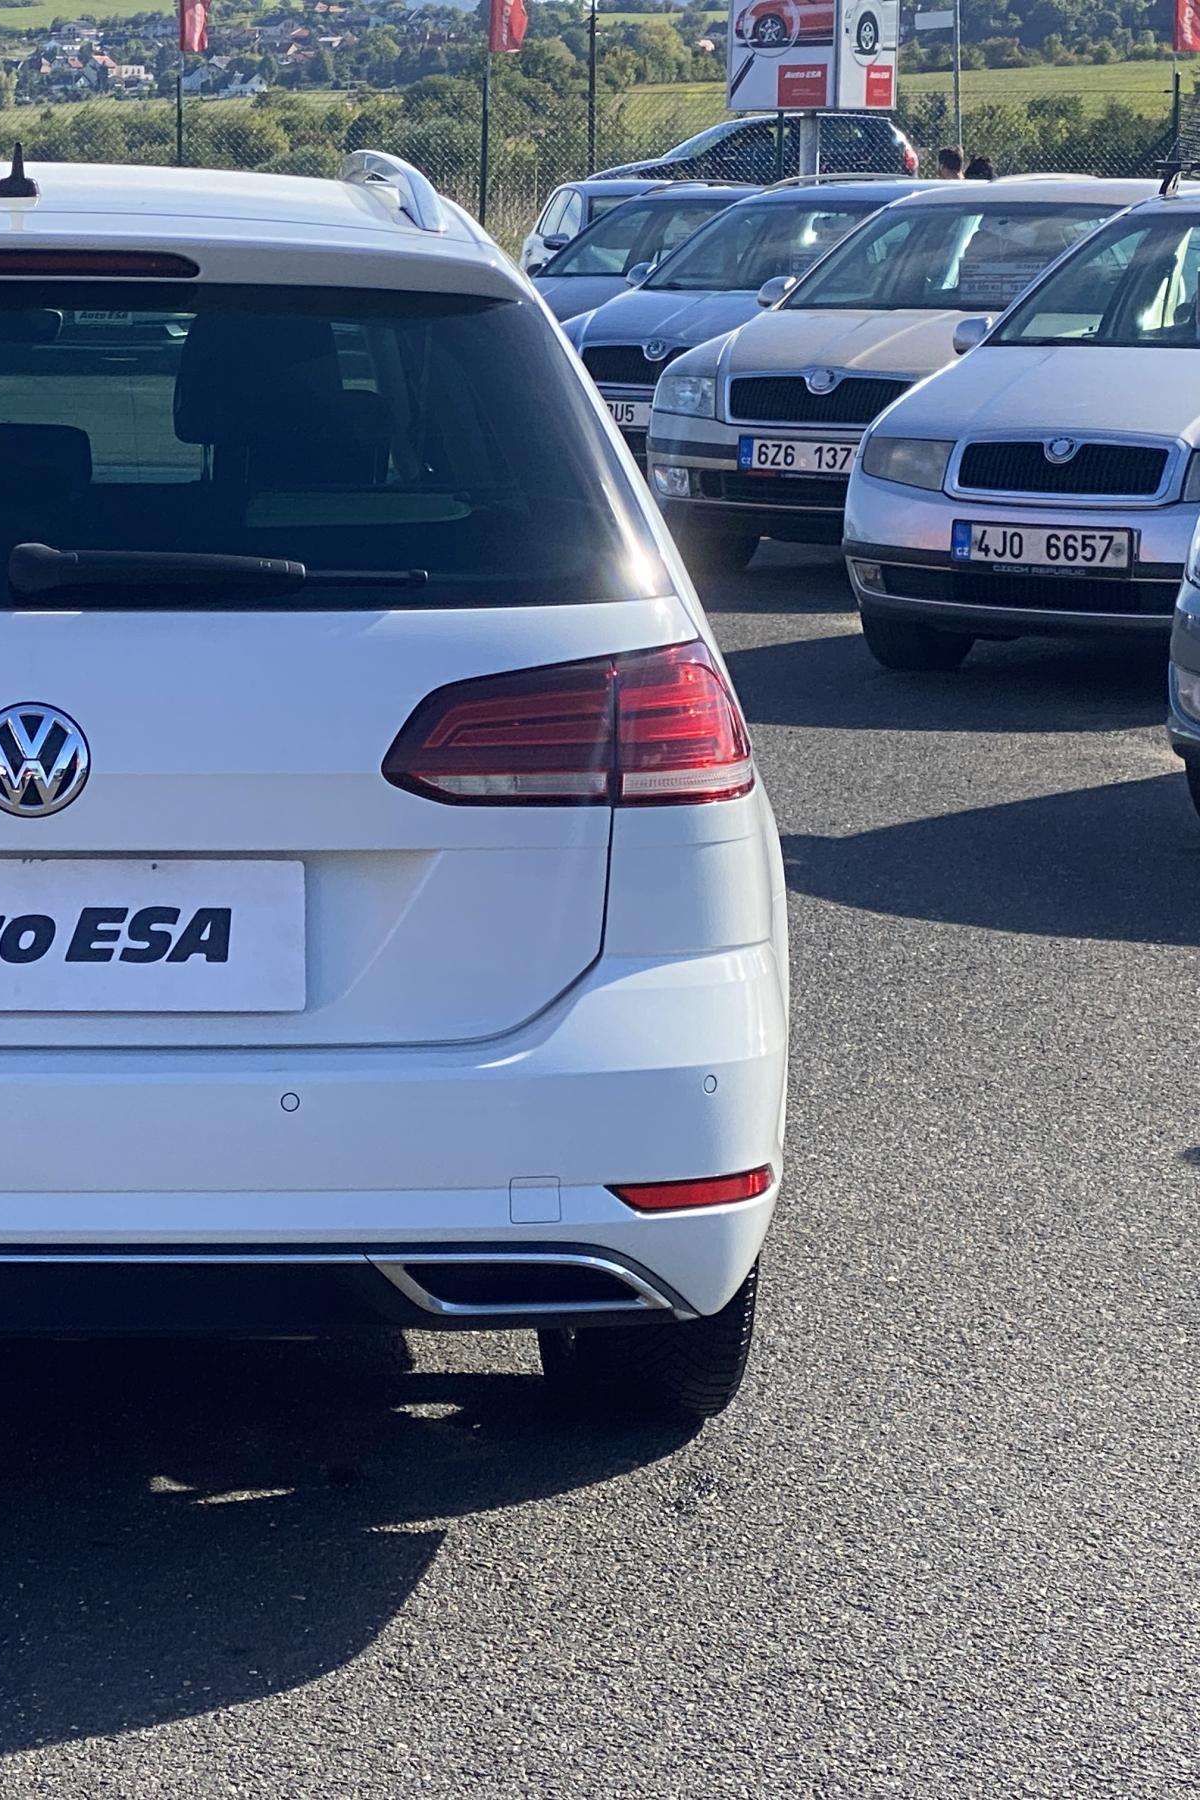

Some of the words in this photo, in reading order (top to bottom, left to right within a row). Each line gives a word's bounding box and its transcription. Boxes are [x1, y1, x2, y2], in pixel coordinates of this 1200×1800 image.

[757, 443, 795, 467] 6Z6
[814, 446, 856, 471] 137
[956, 547, 969, 556] CZ
[1046, 534, 1114, 563] 6657
[992, 564, 1029, 574] CZECH
[1031, 566, 1086, 576] REPUBLIC
[65, 906, 231, 963] ESA
